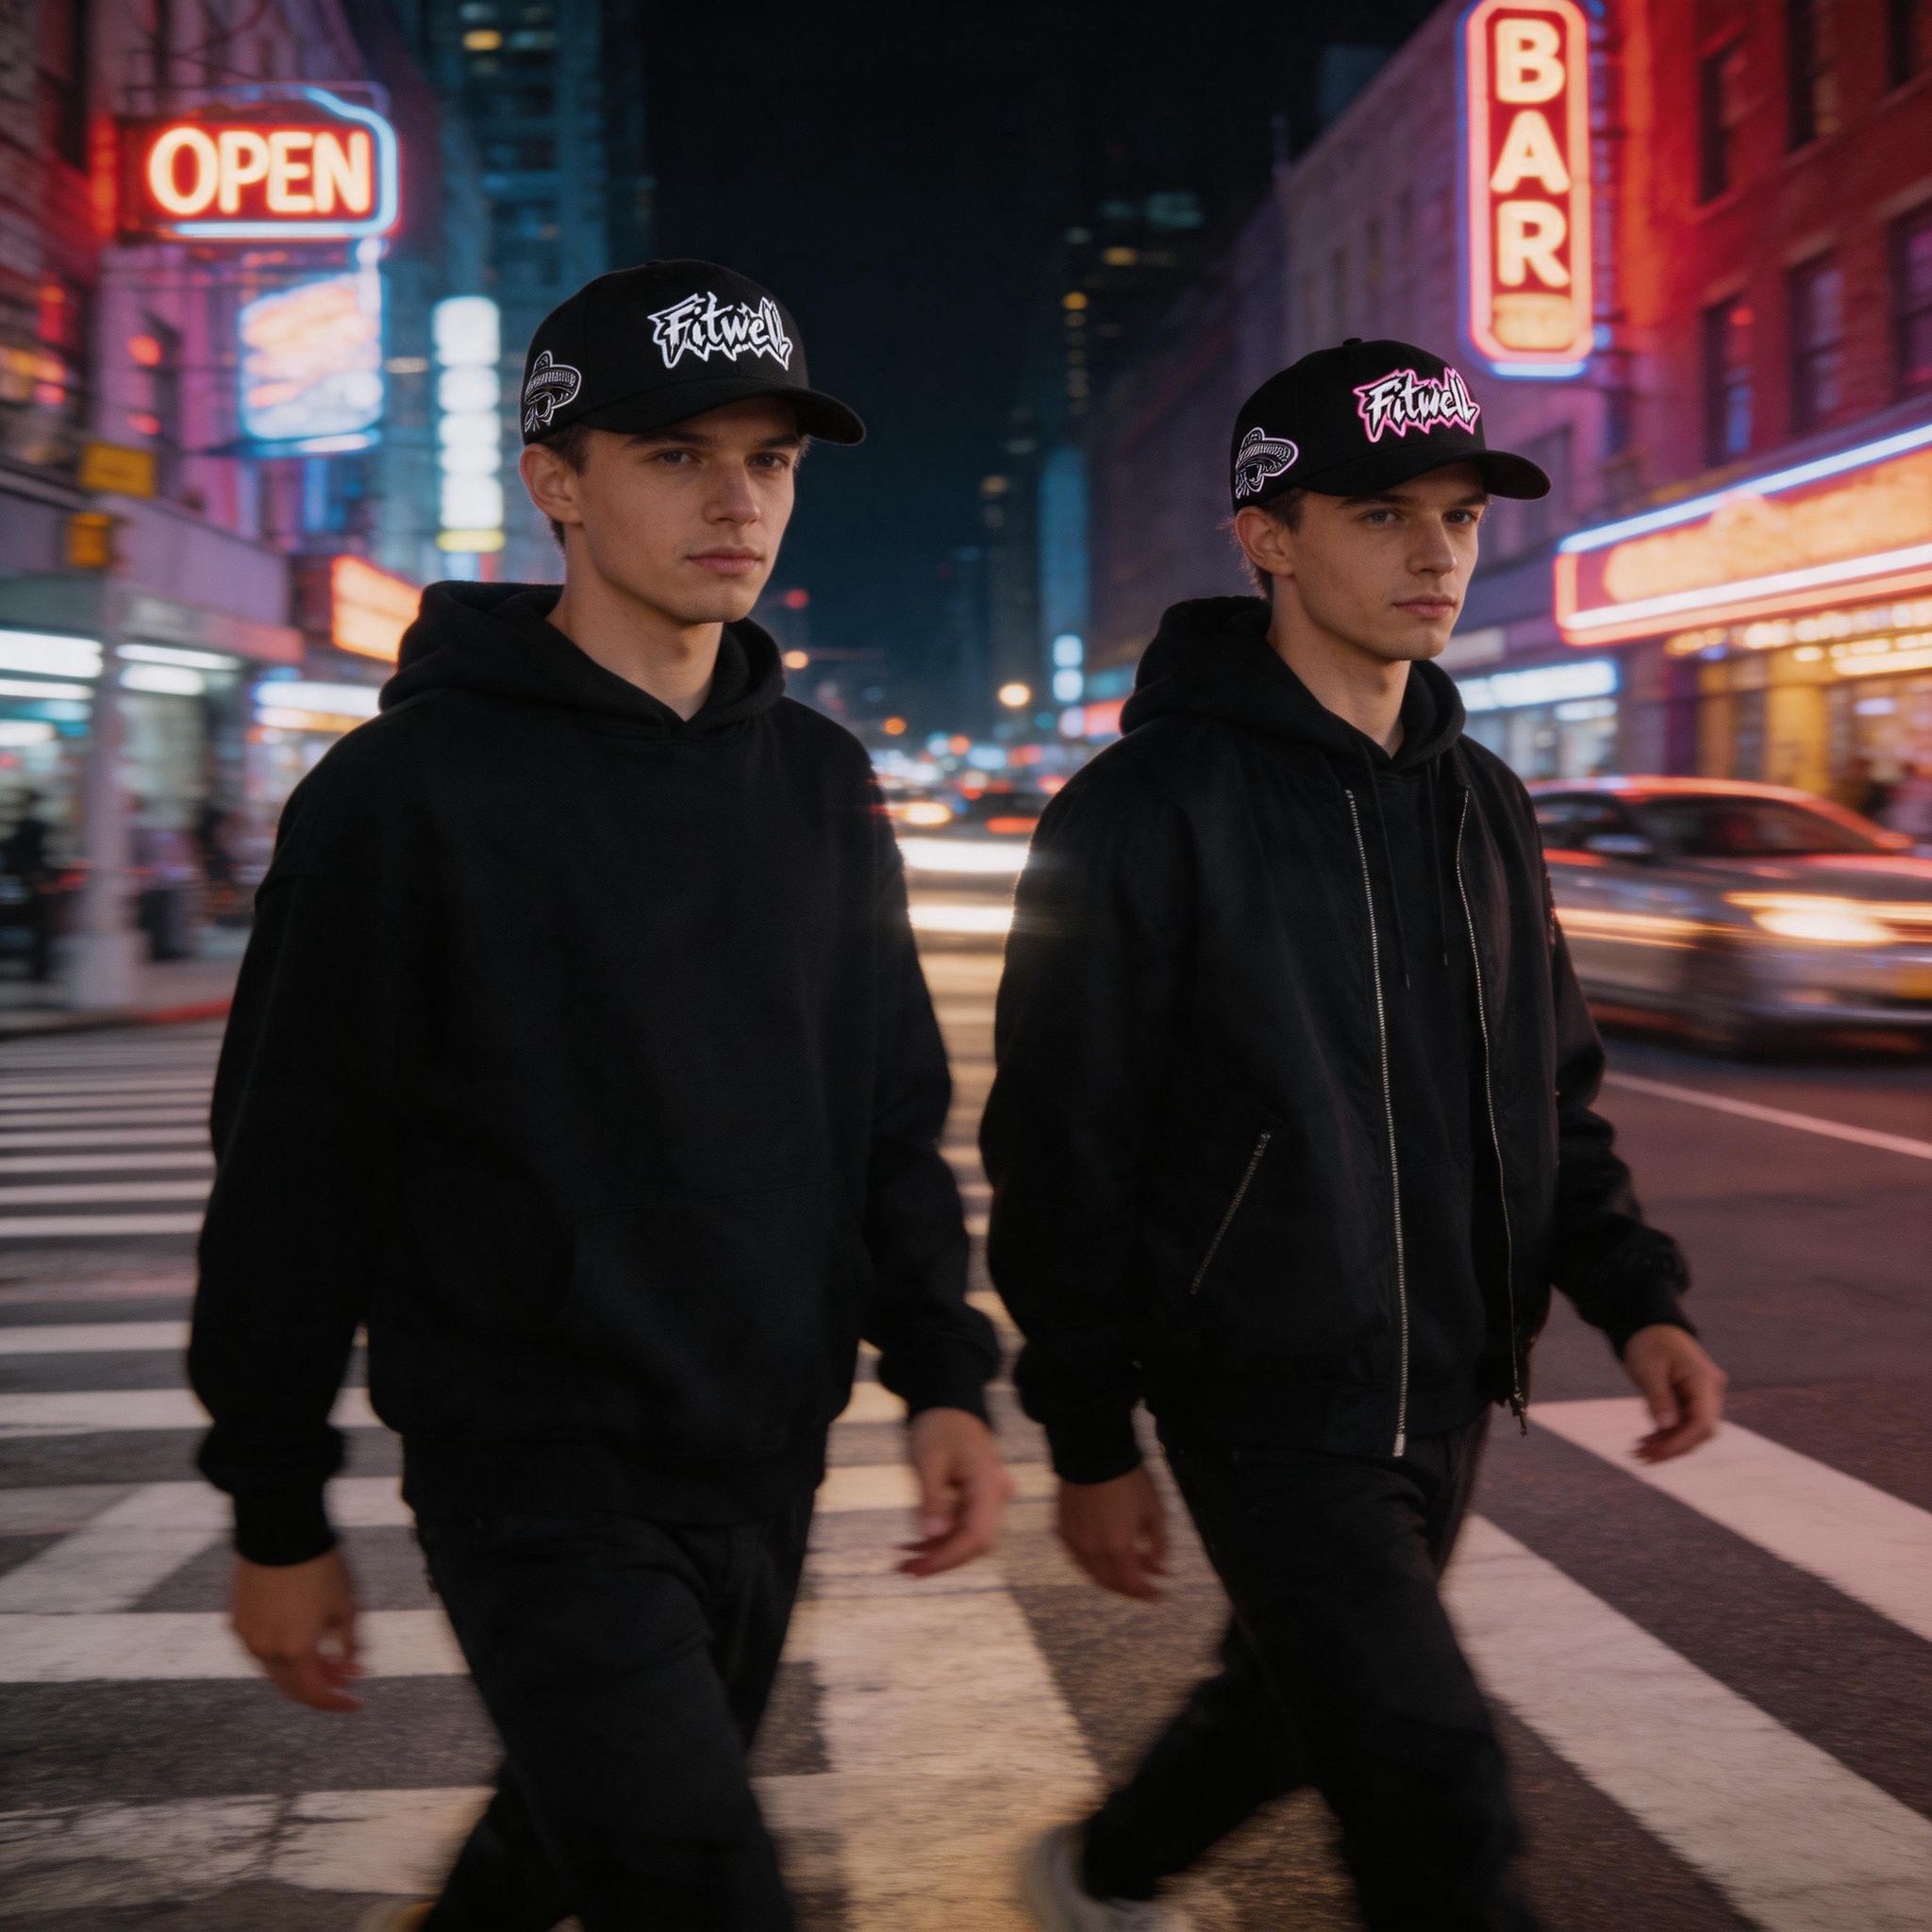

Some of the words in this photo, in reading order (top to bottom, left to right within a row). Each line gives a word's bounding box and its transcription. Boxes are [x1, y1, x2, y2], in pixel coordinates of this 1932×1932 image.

[148, 126, 372, 215] OPEN
[1491, 18, 1571, 288] BAR
[647, 291, 792, 371] Fitwell
[1353, 367, 1480, 442] Fitwell
